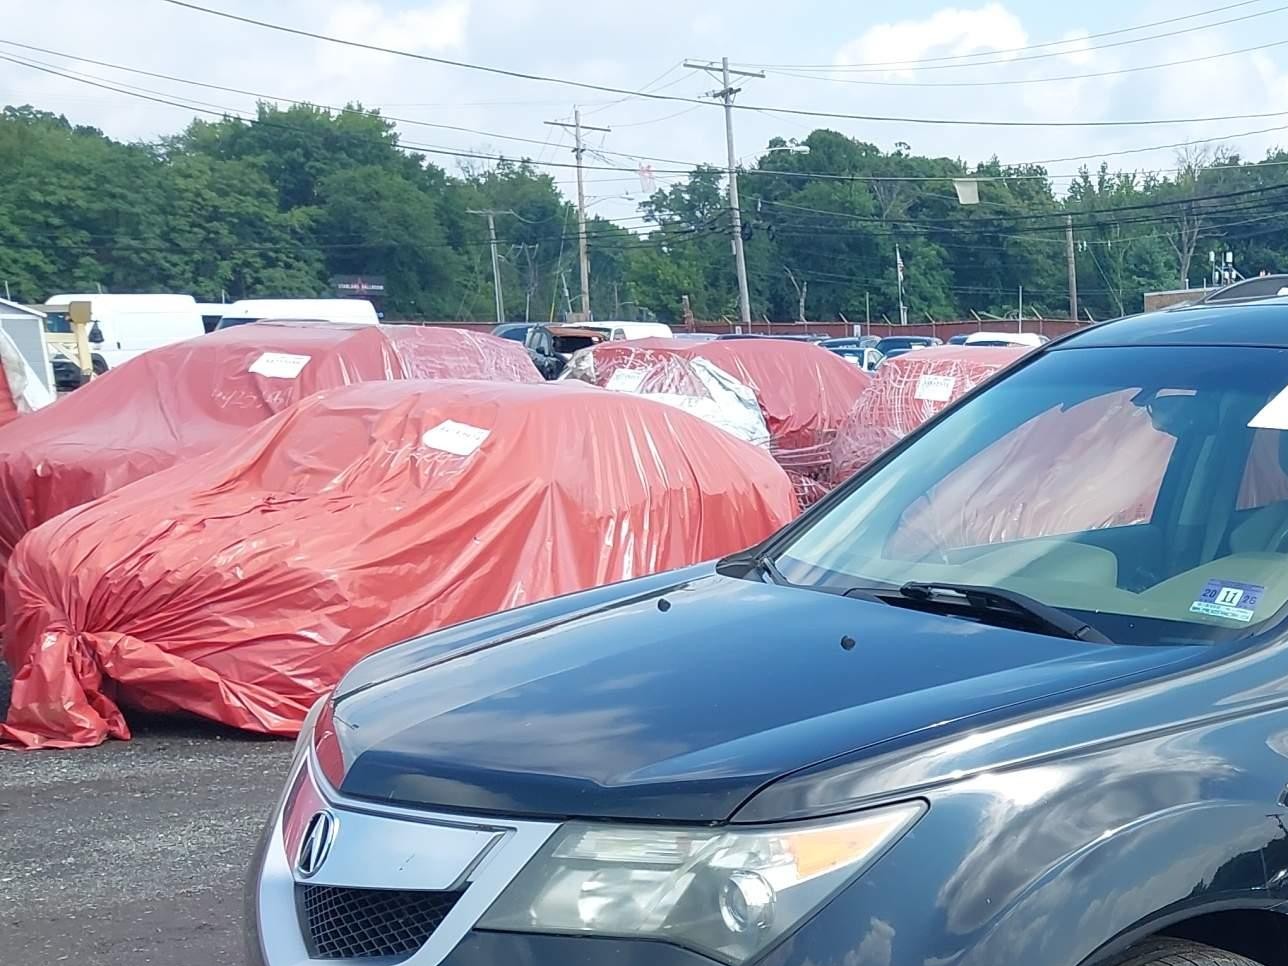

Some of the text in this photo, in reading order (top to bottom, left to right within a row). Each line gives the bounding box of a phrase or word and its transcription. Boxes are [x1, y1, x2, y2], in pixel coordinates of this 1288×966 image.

[1202, 588, 1257, 605] 20 11 26
